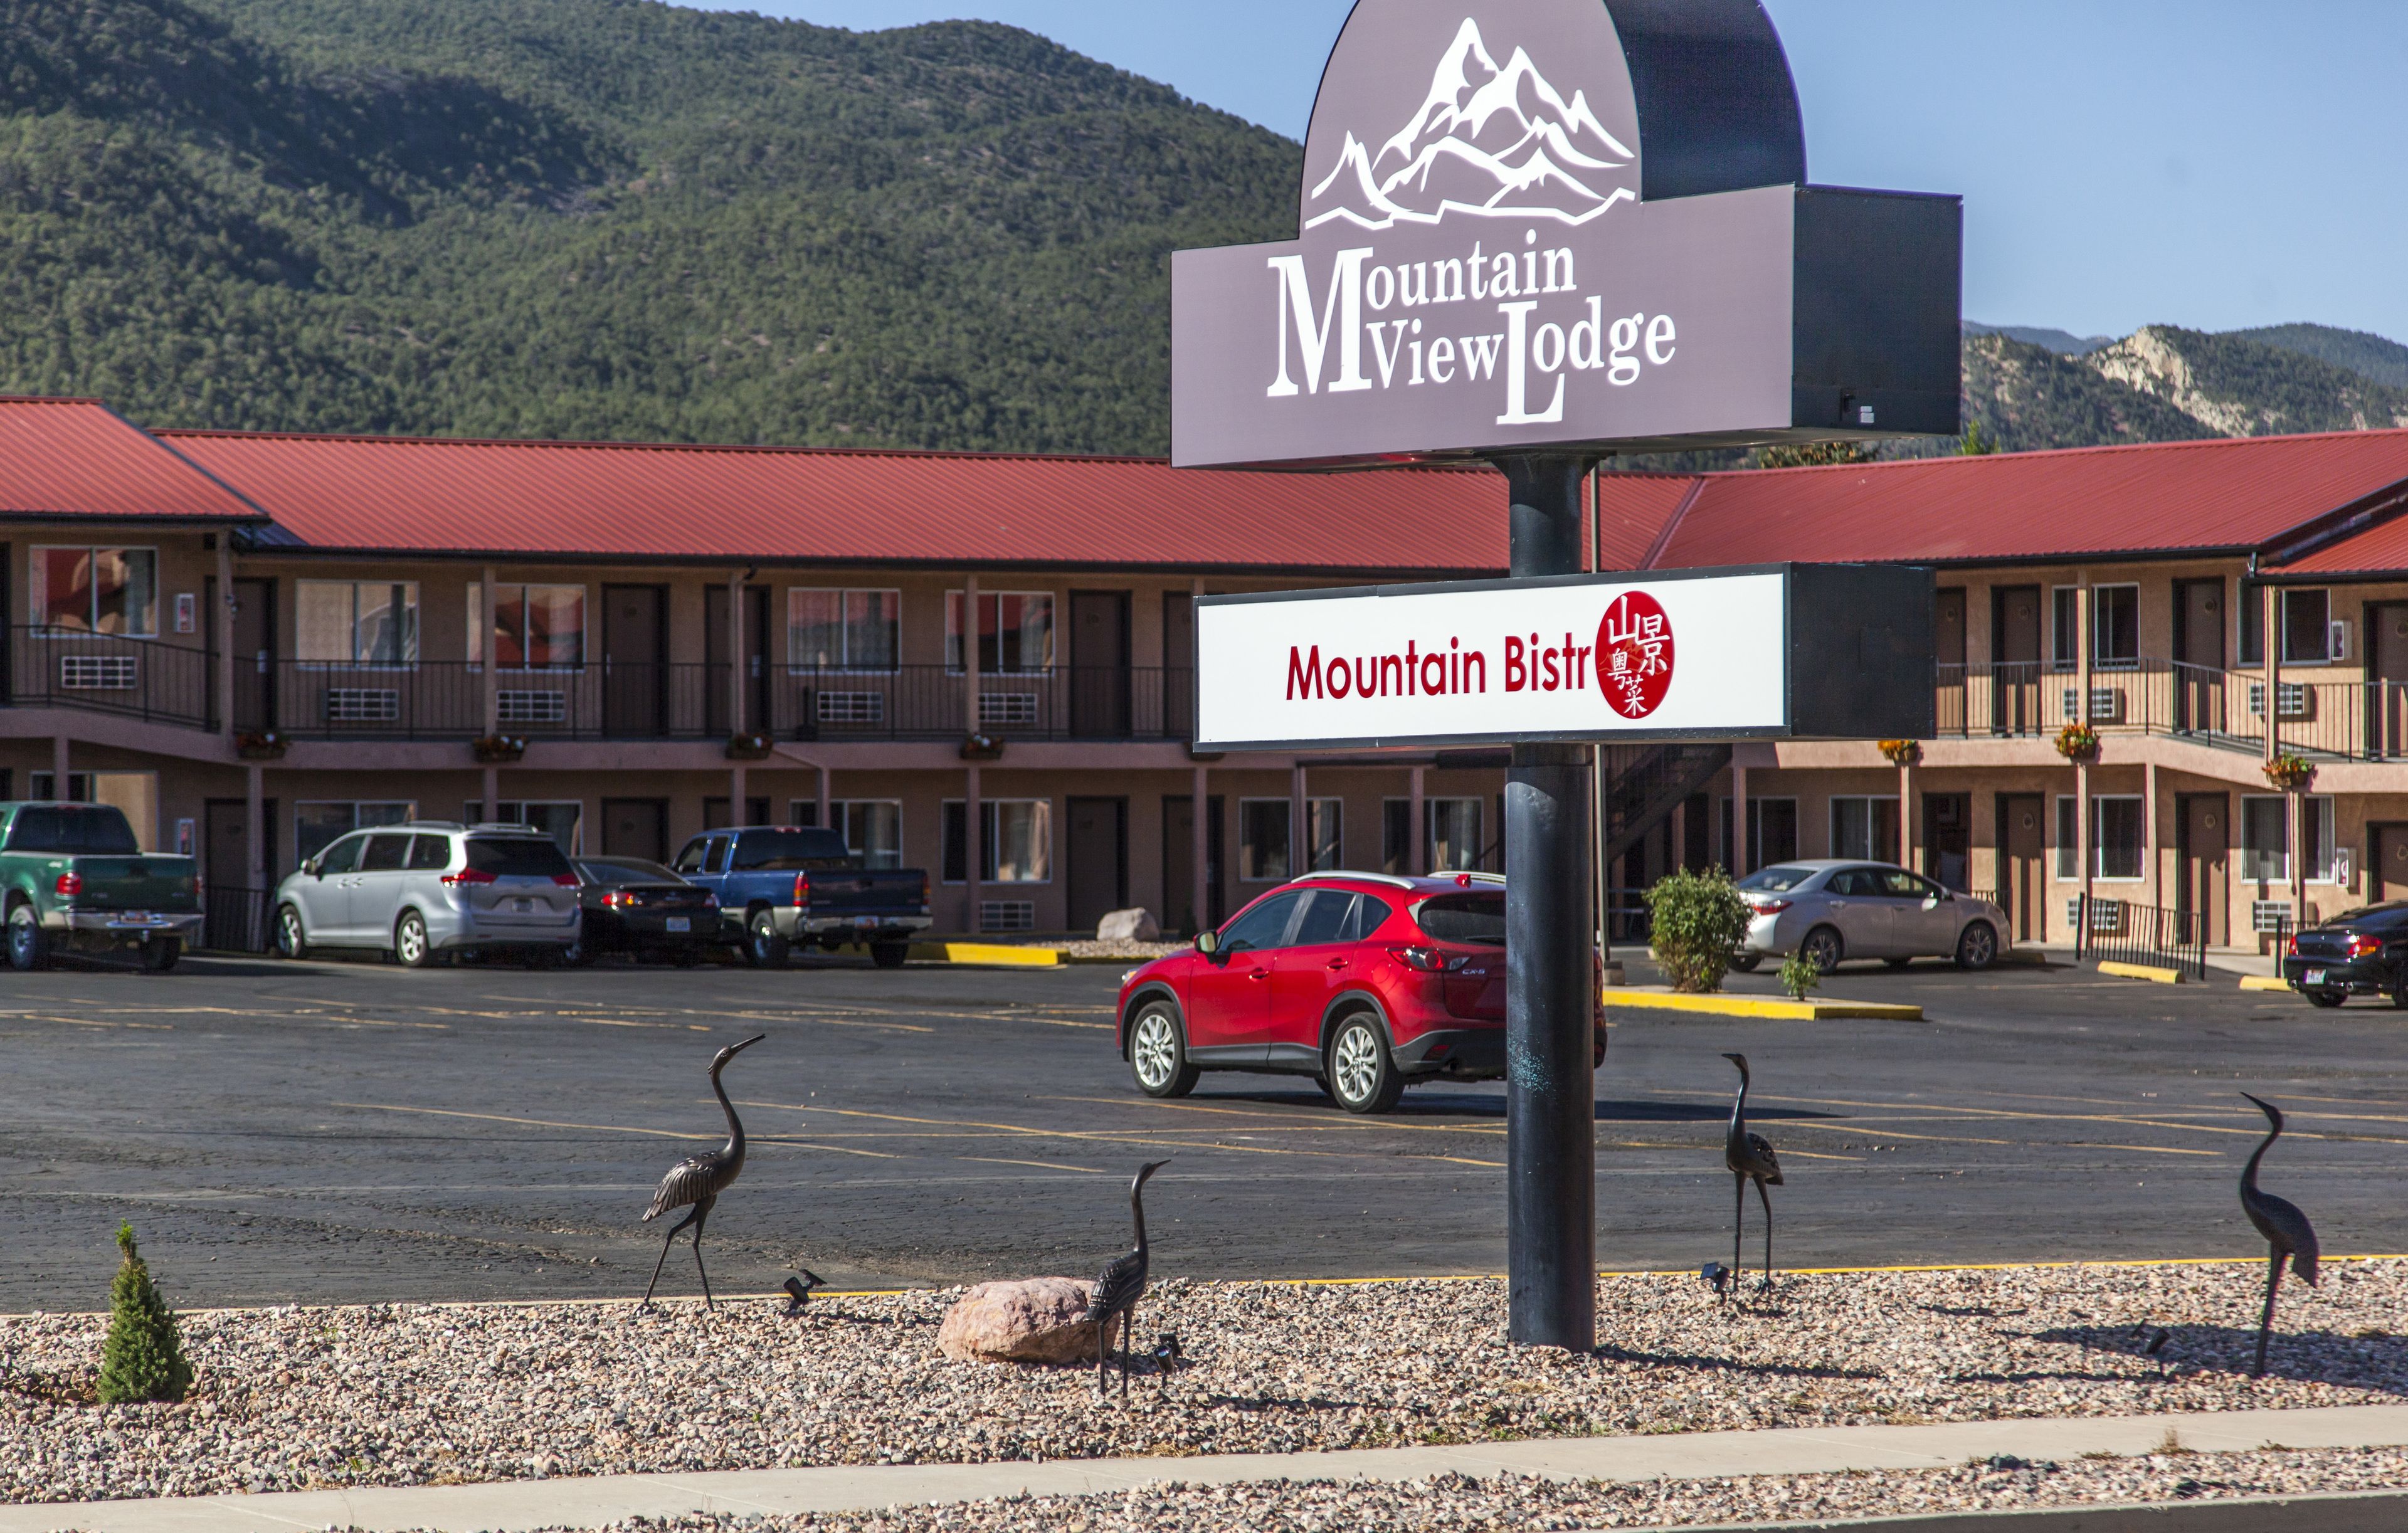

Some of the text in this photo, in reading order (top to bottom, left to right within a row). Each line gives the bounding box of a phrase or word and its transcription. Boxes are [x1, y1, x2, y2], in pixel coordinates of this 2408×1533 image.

[1267, 229, 1577, 397] Mountain
[1366, 295, 1677, 426] View Lodge
[1286, 636, 1486, 700] Mountain
